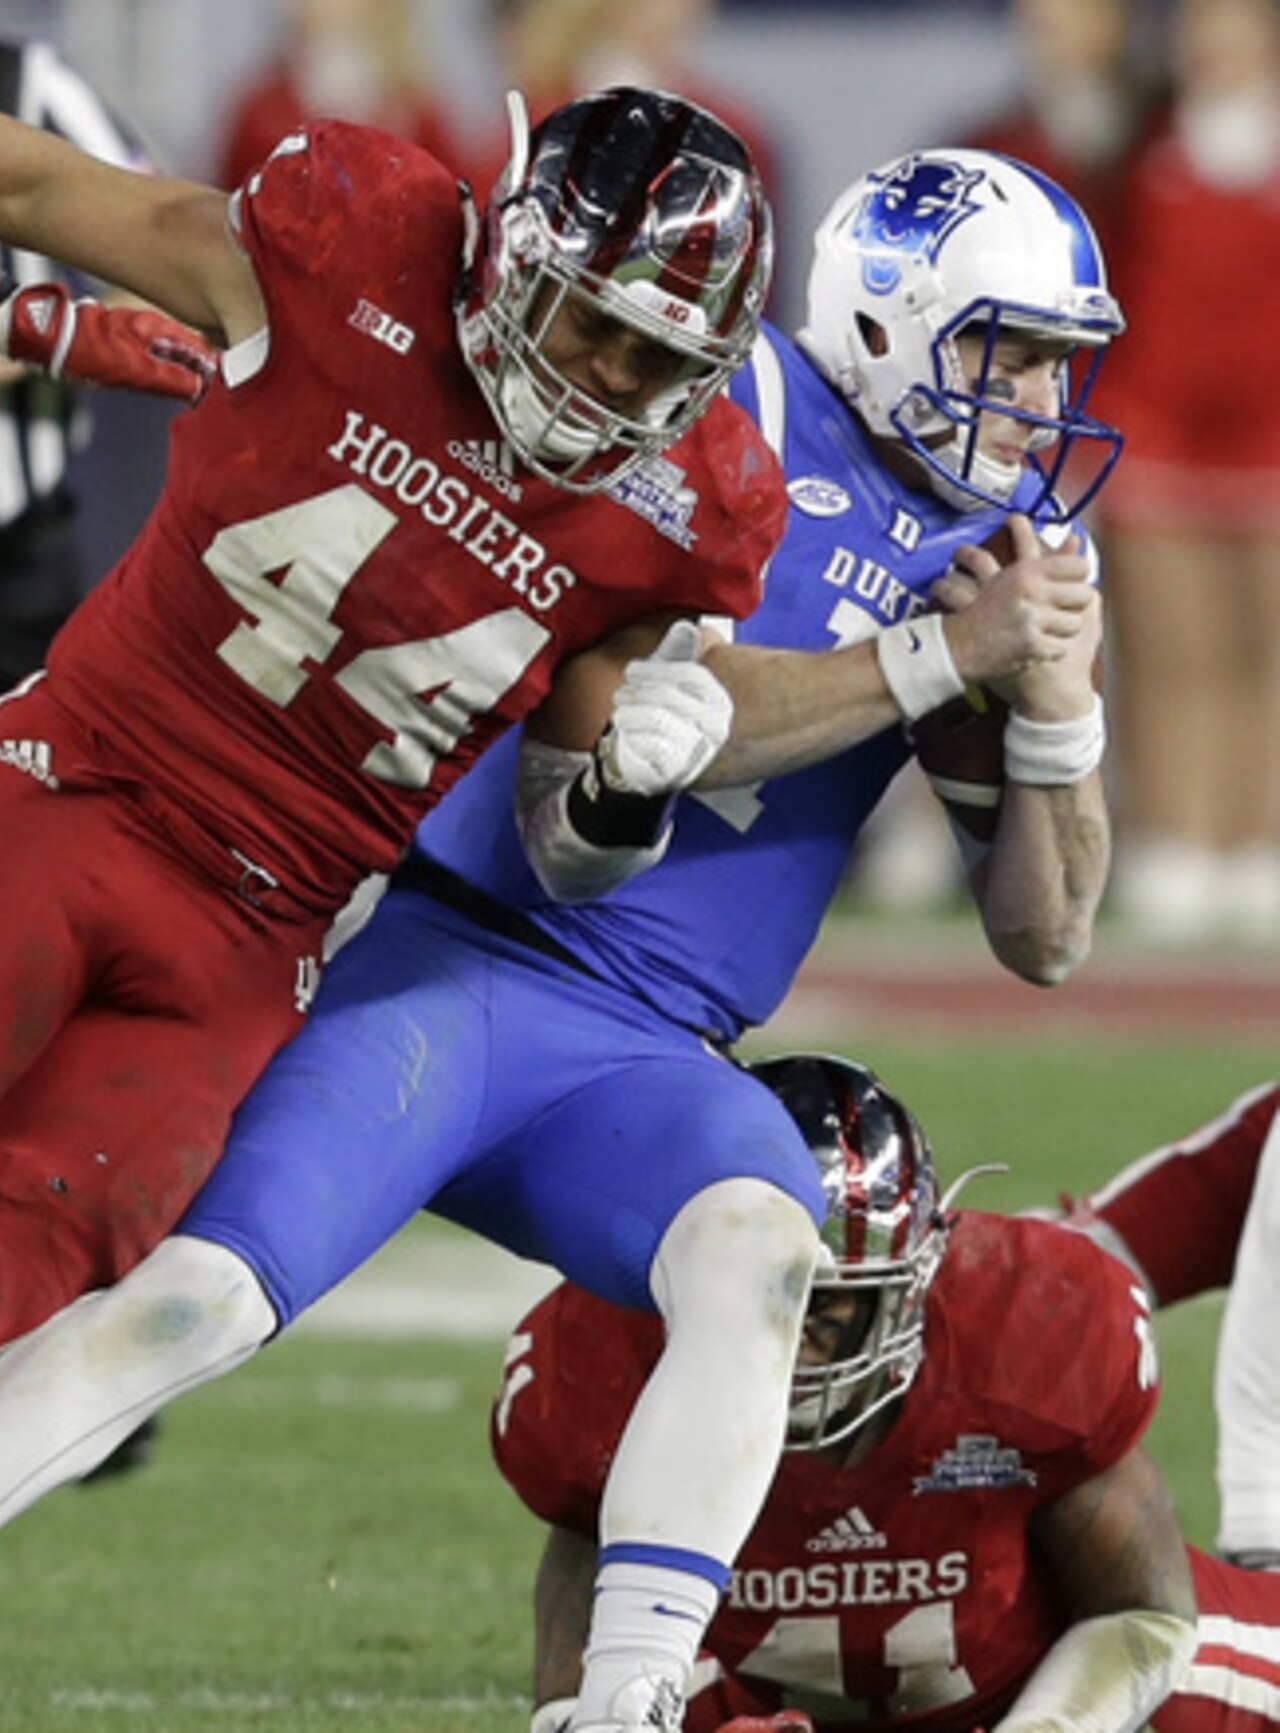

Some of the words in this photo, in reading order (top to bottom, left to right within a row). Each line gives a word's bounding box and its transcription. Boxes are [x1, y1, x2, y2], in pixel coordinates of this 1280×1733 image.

[328, 409, 576, 611] HOOSIERS
[201, 482, 553, 790] 44
[735, 1600, 978, 1722] 41
